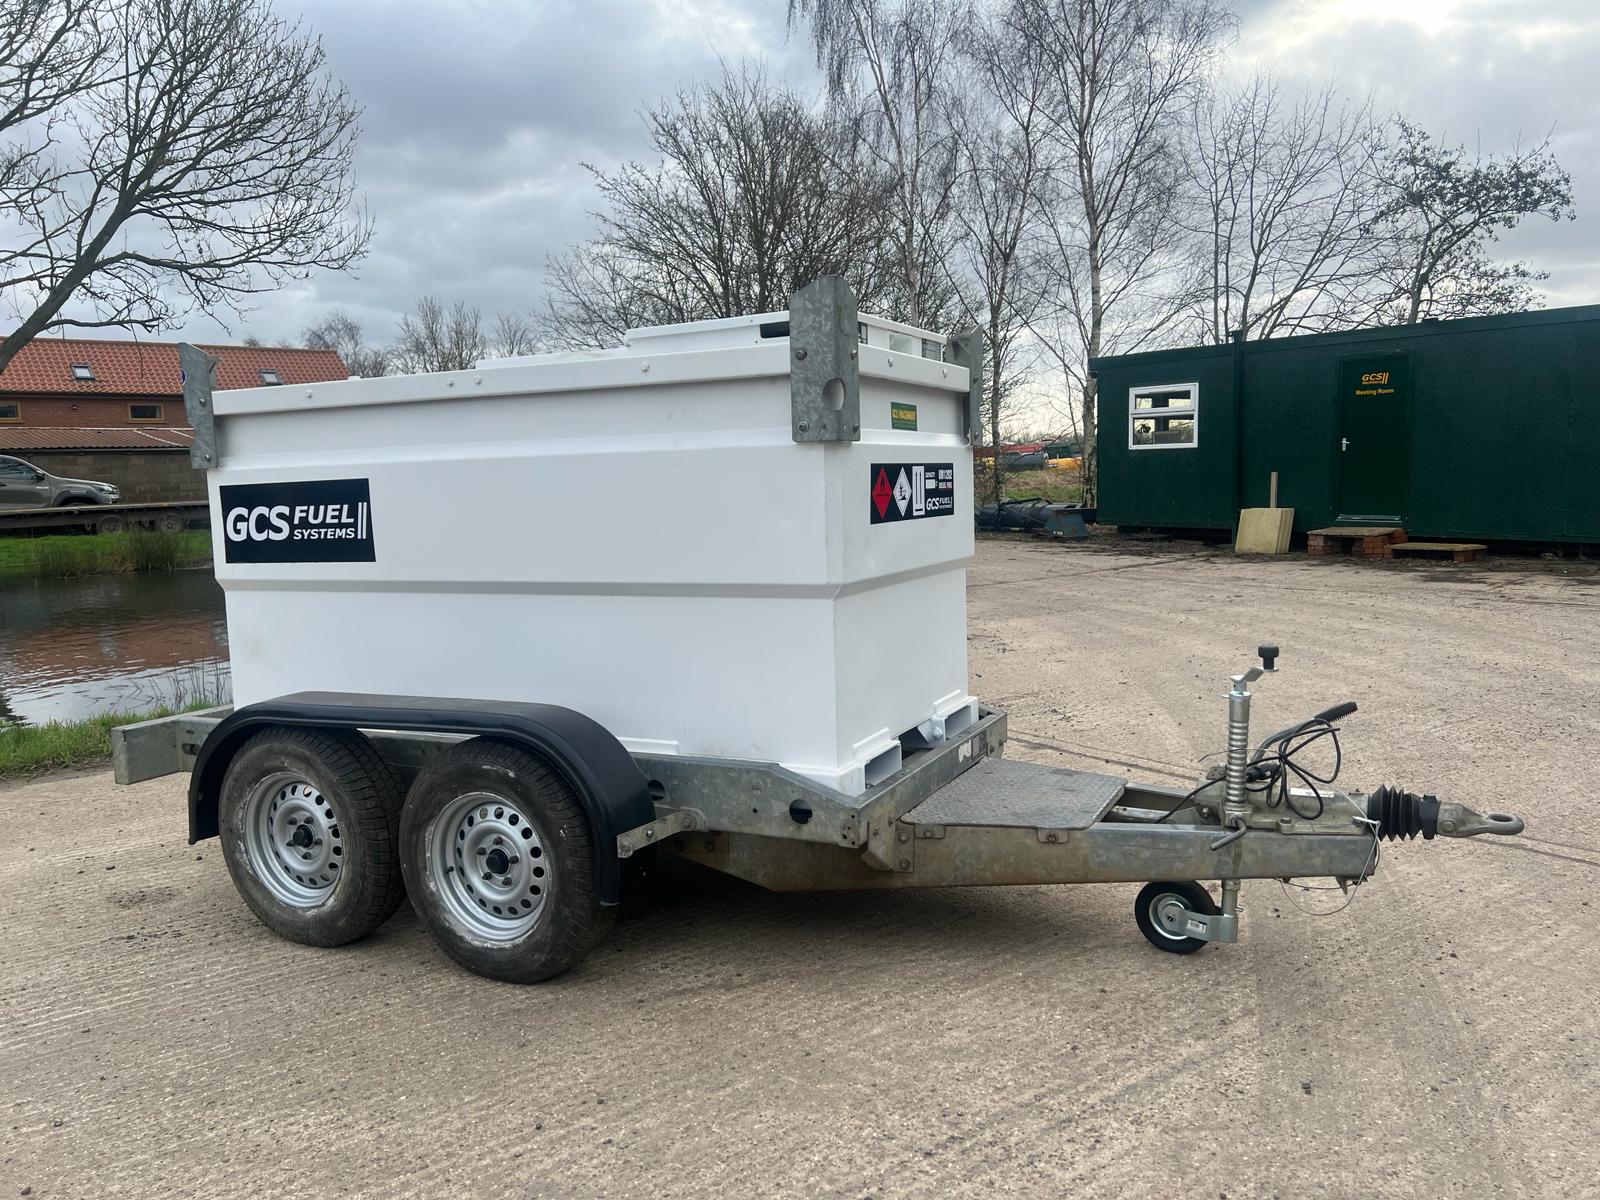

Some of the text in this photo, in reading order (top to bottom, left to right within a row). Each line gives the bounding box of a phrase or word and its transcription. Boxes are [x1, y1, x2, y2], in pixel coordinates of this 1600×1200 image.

[1362, 373, 1383, 381] GCS
[926, 496, 951, 511] GCS FUEL
[226, 504, 355, 542] GCS FUEL
[293, 528, 356, 540] SYSTEMS
